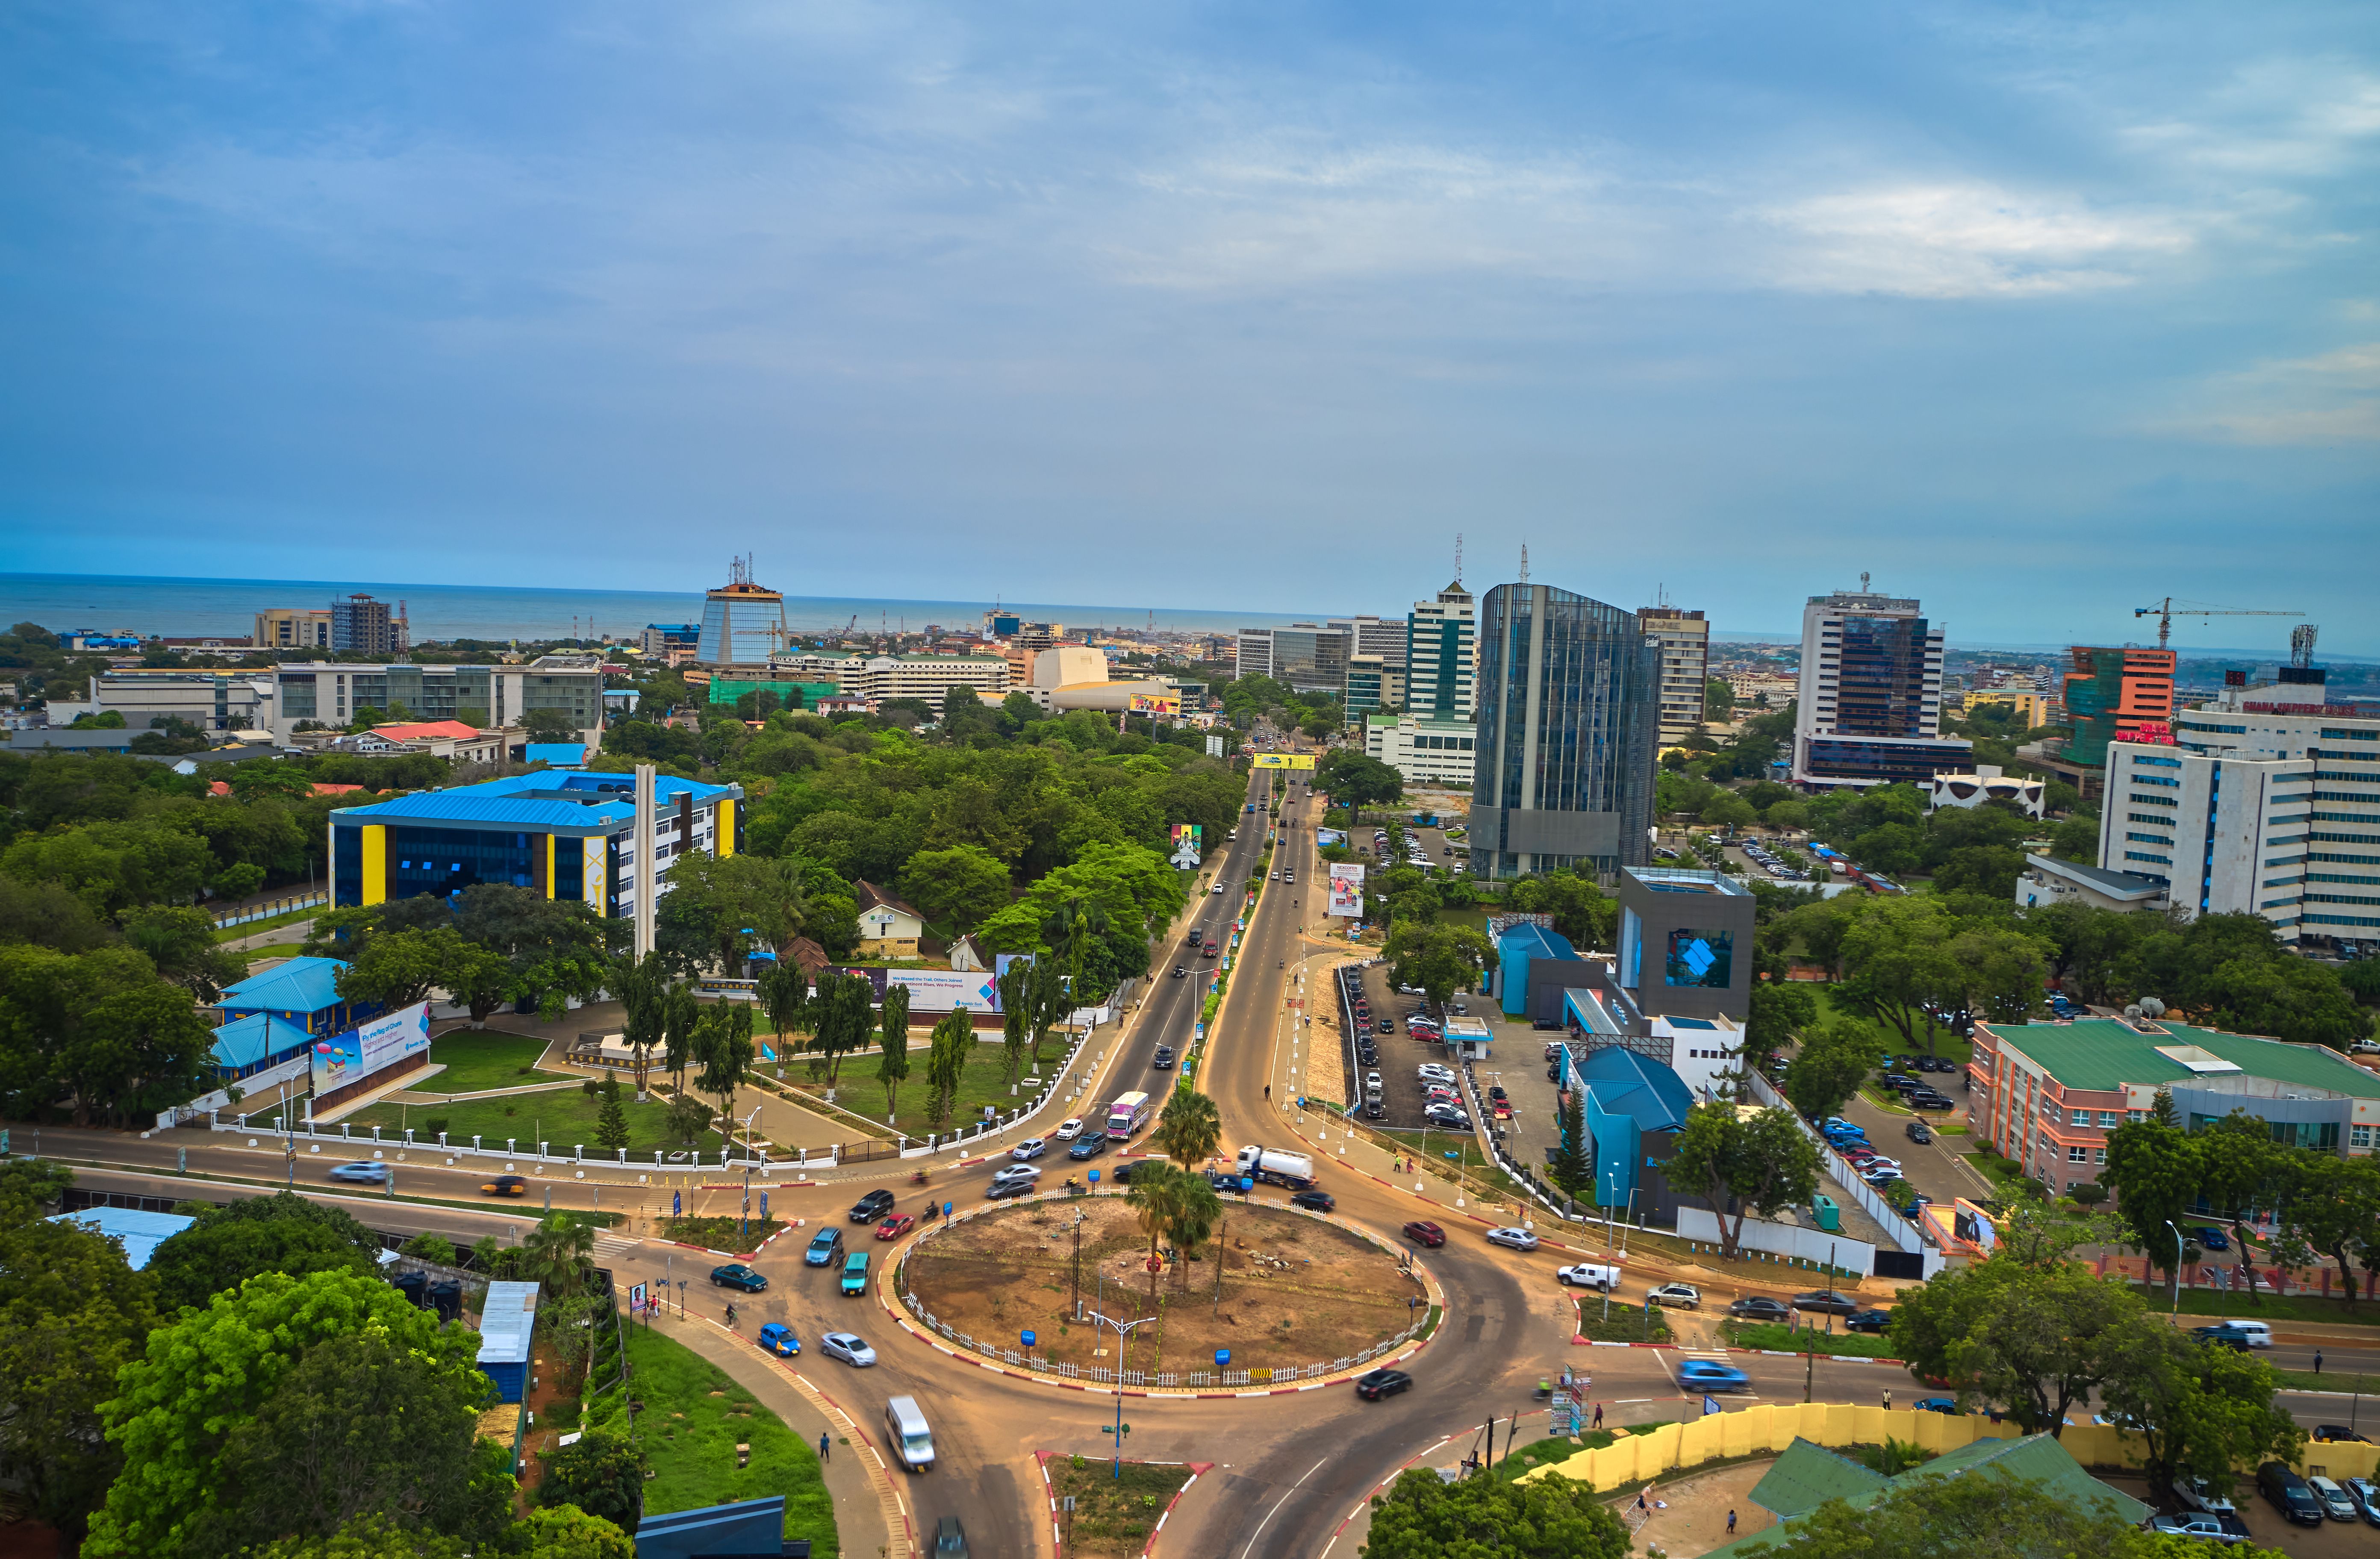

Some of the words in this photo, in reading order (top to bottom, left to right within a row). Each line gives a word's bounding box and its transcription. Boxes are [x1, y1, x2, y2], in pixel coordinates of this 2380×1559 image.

[2243, 701, 2274, 712] GHANA
[390, 1021, 402, 1029] Ghana
[363, 1040, 377, 1049] Higher
[385, 1031, 398, 1040] Higher
